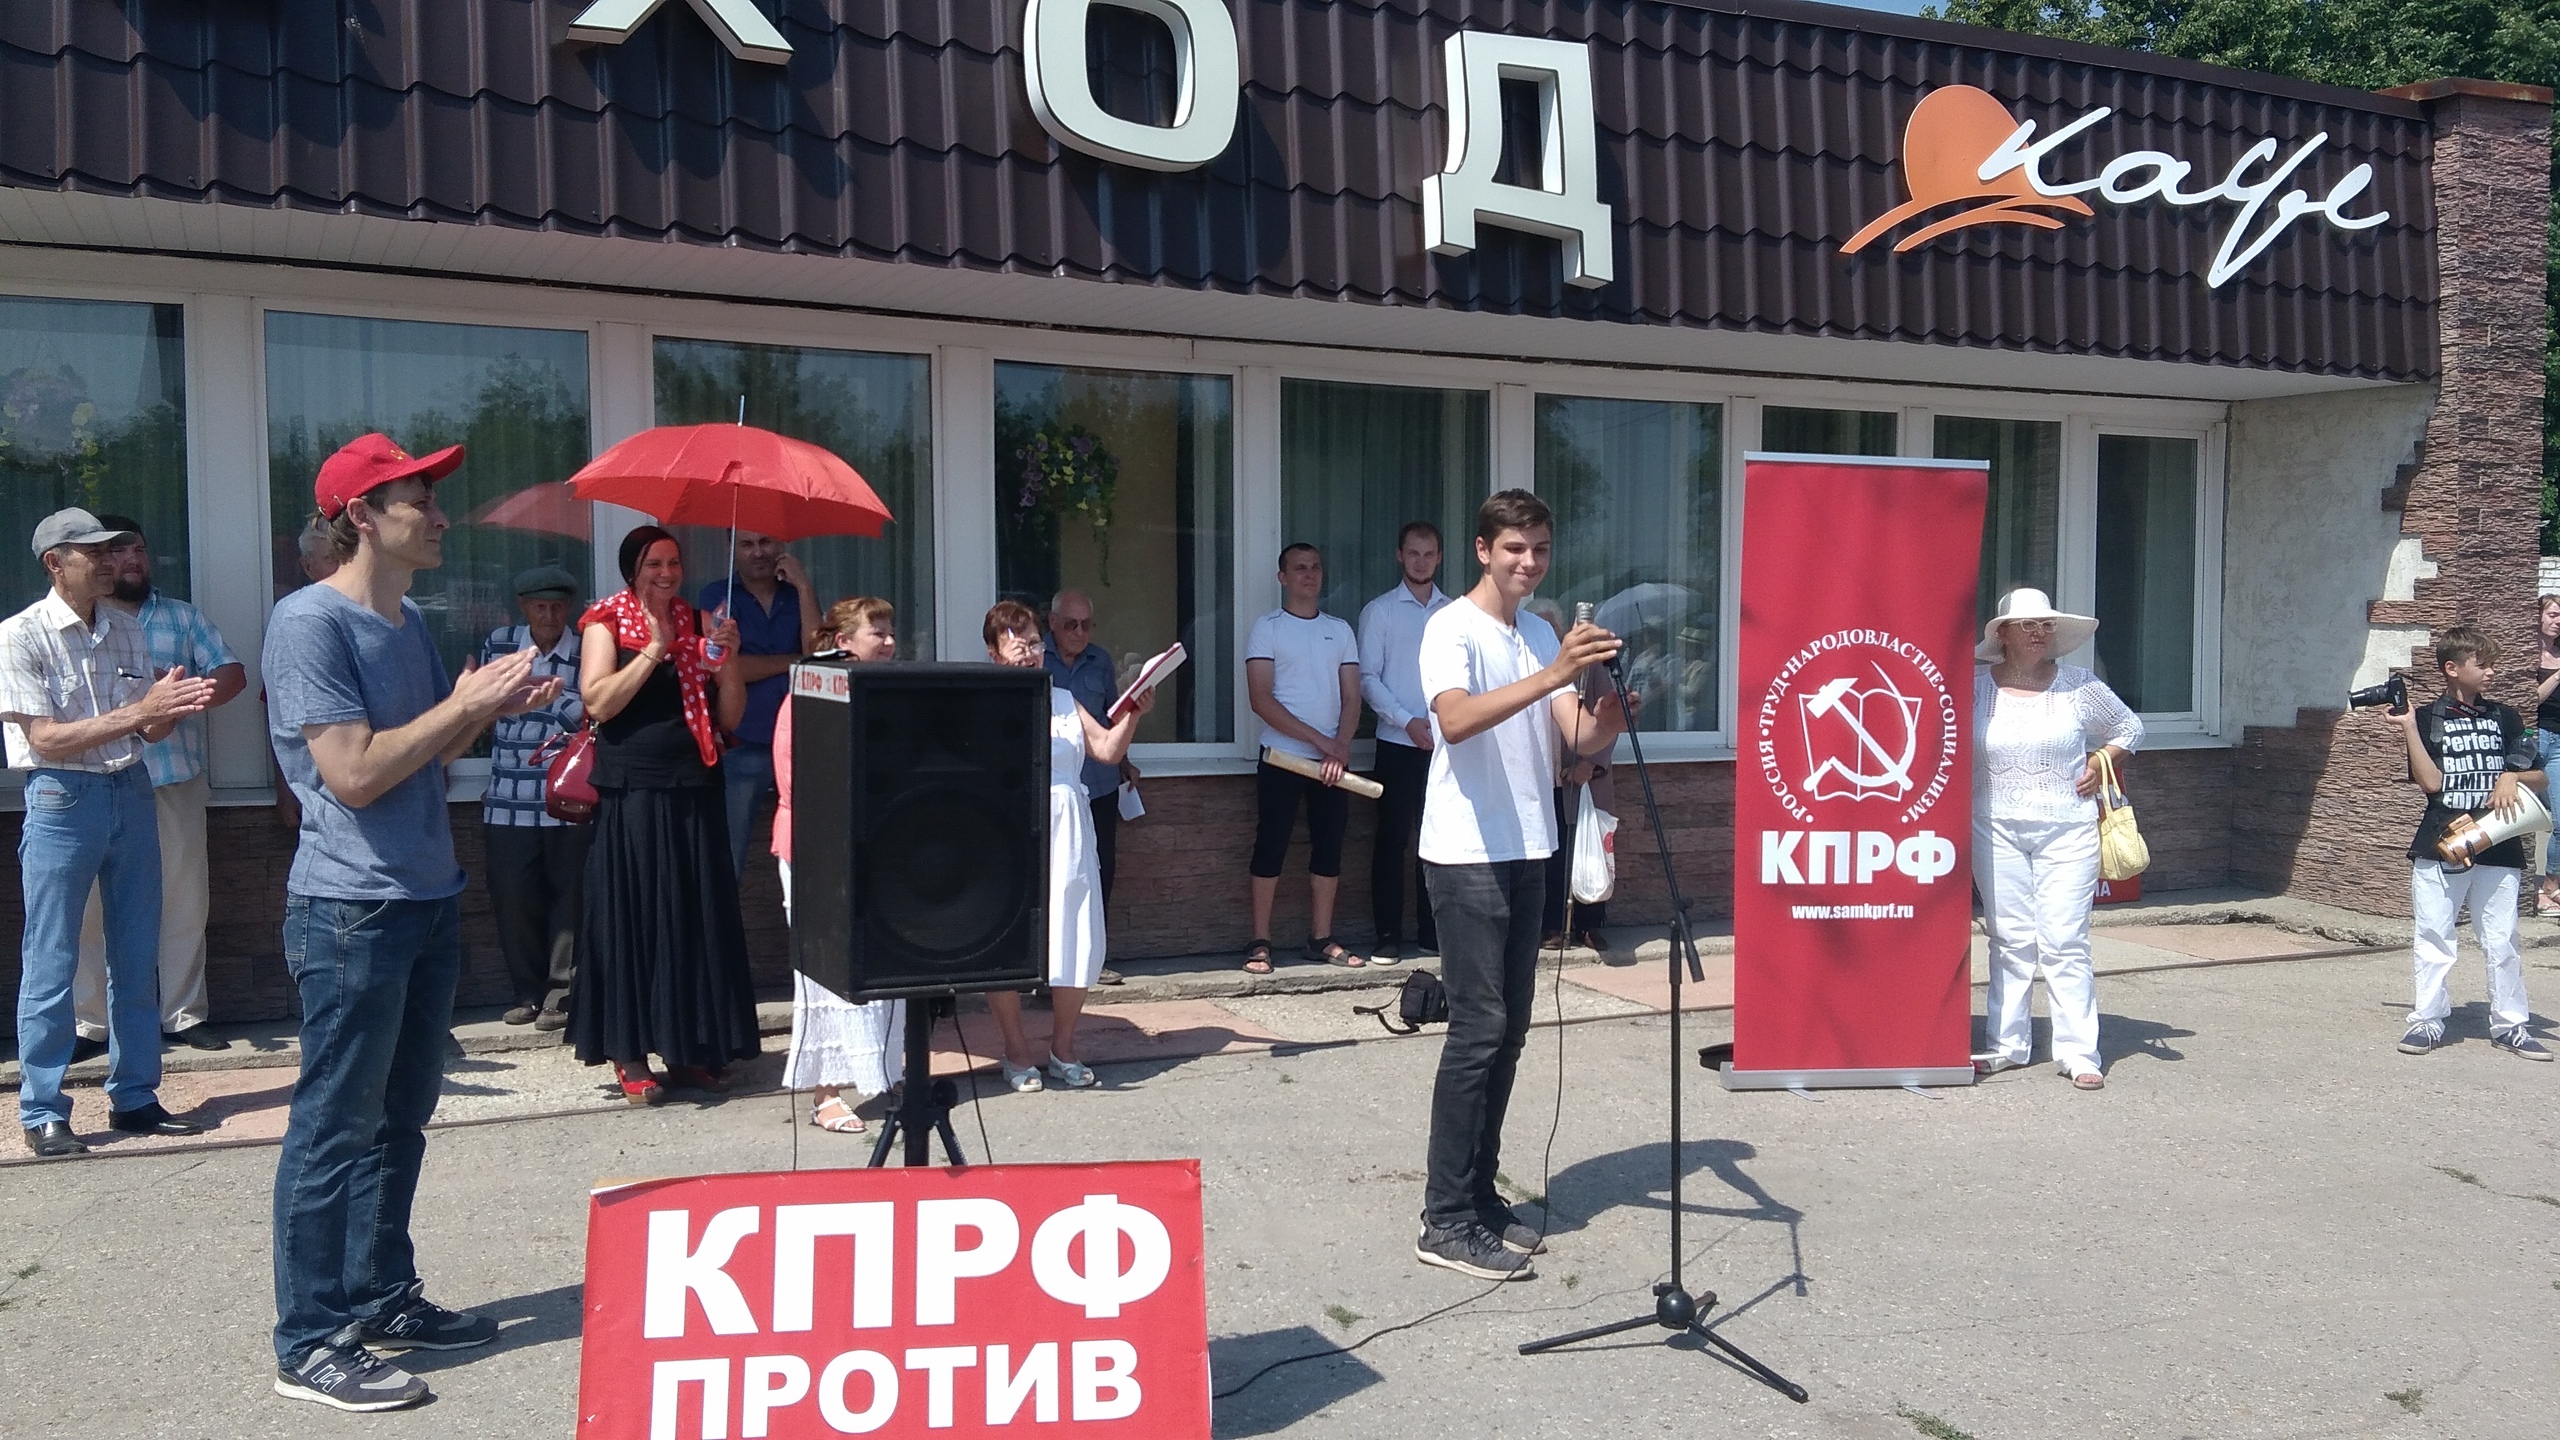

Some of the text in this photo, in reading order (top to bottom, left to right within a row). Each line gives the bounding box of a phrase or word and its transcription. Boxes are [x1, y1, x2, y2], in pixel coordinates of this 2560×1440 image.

[567, 0, 1613, 288] ОД
[1785, 628, 1944, 688] НАРОДОВЛАСТИЕ
[1759, 676, 1791, 728] ТРУД
[1906, 693, 1957, 822] СОЦИАЛИЗМ
[2441, 732, 2503, 754] Perfec
[2443, 754, 2475, 773] But
[2475, 753, 2484, 770] I
[1759, 740, 1808, 822] РОССИЯ
[1761, 830, 1956, 884] КПРФ
[1791, 903, 1914, 920] www.samkprf.ru
[643, 1193, 1172, 1339] КПРФ
[649, 1338, 1142, 1440] ПРОТИВ
